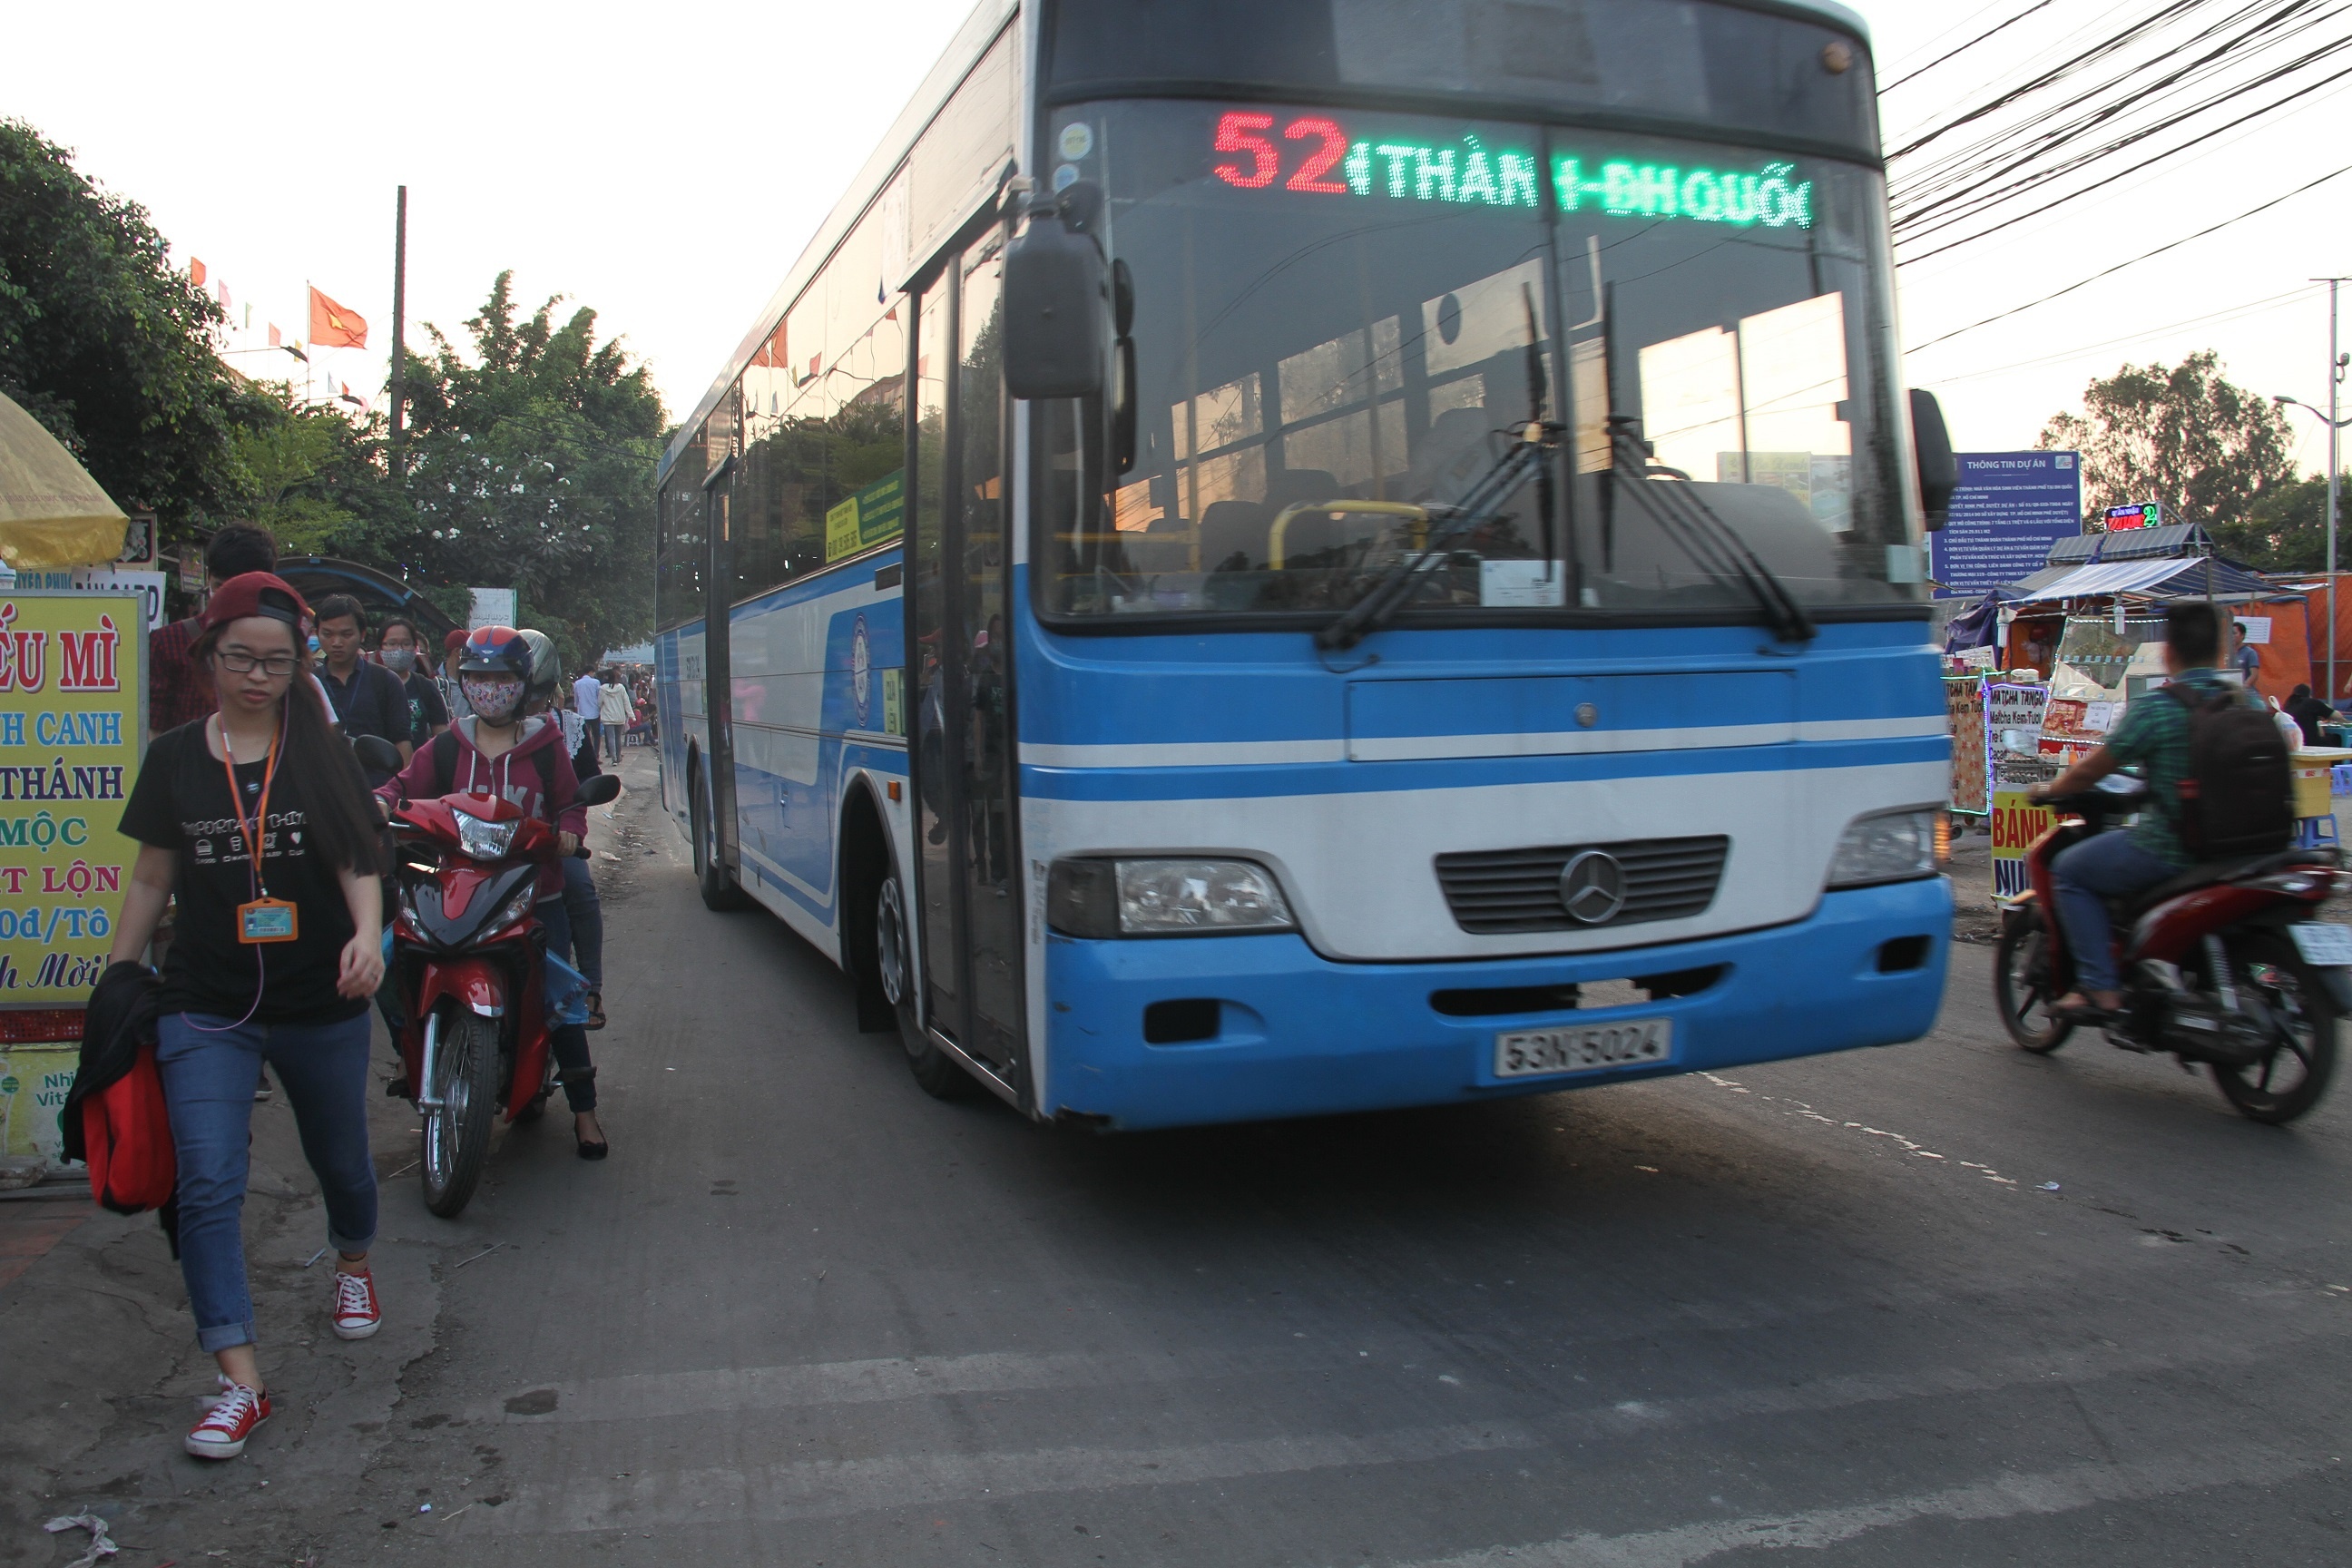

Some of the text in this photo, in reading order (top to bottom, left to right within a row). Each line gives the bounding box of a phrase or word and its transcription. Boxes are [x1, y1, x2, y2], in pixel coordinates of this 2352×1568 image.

[1214, 112, 1348, 194] 52
[1967, 458, 2046, 470] THÔNG TIN DỰ ÁN
[58, 613, 122, 692] MÌ
[1990, 690, 2044, 706] MATCHA TANGO
[1990, 710, 2011, 724] Matcha
[2012, 710, 2026, 724] Kem
[36, 711, 122, 746] CANH
[0, 756, 124, 800] THÁNH
[0, 810, 88, 853] MỘC
[1992, 799, 2048, 848] BÁNH
[42, 859, 121, 898] LỘN
